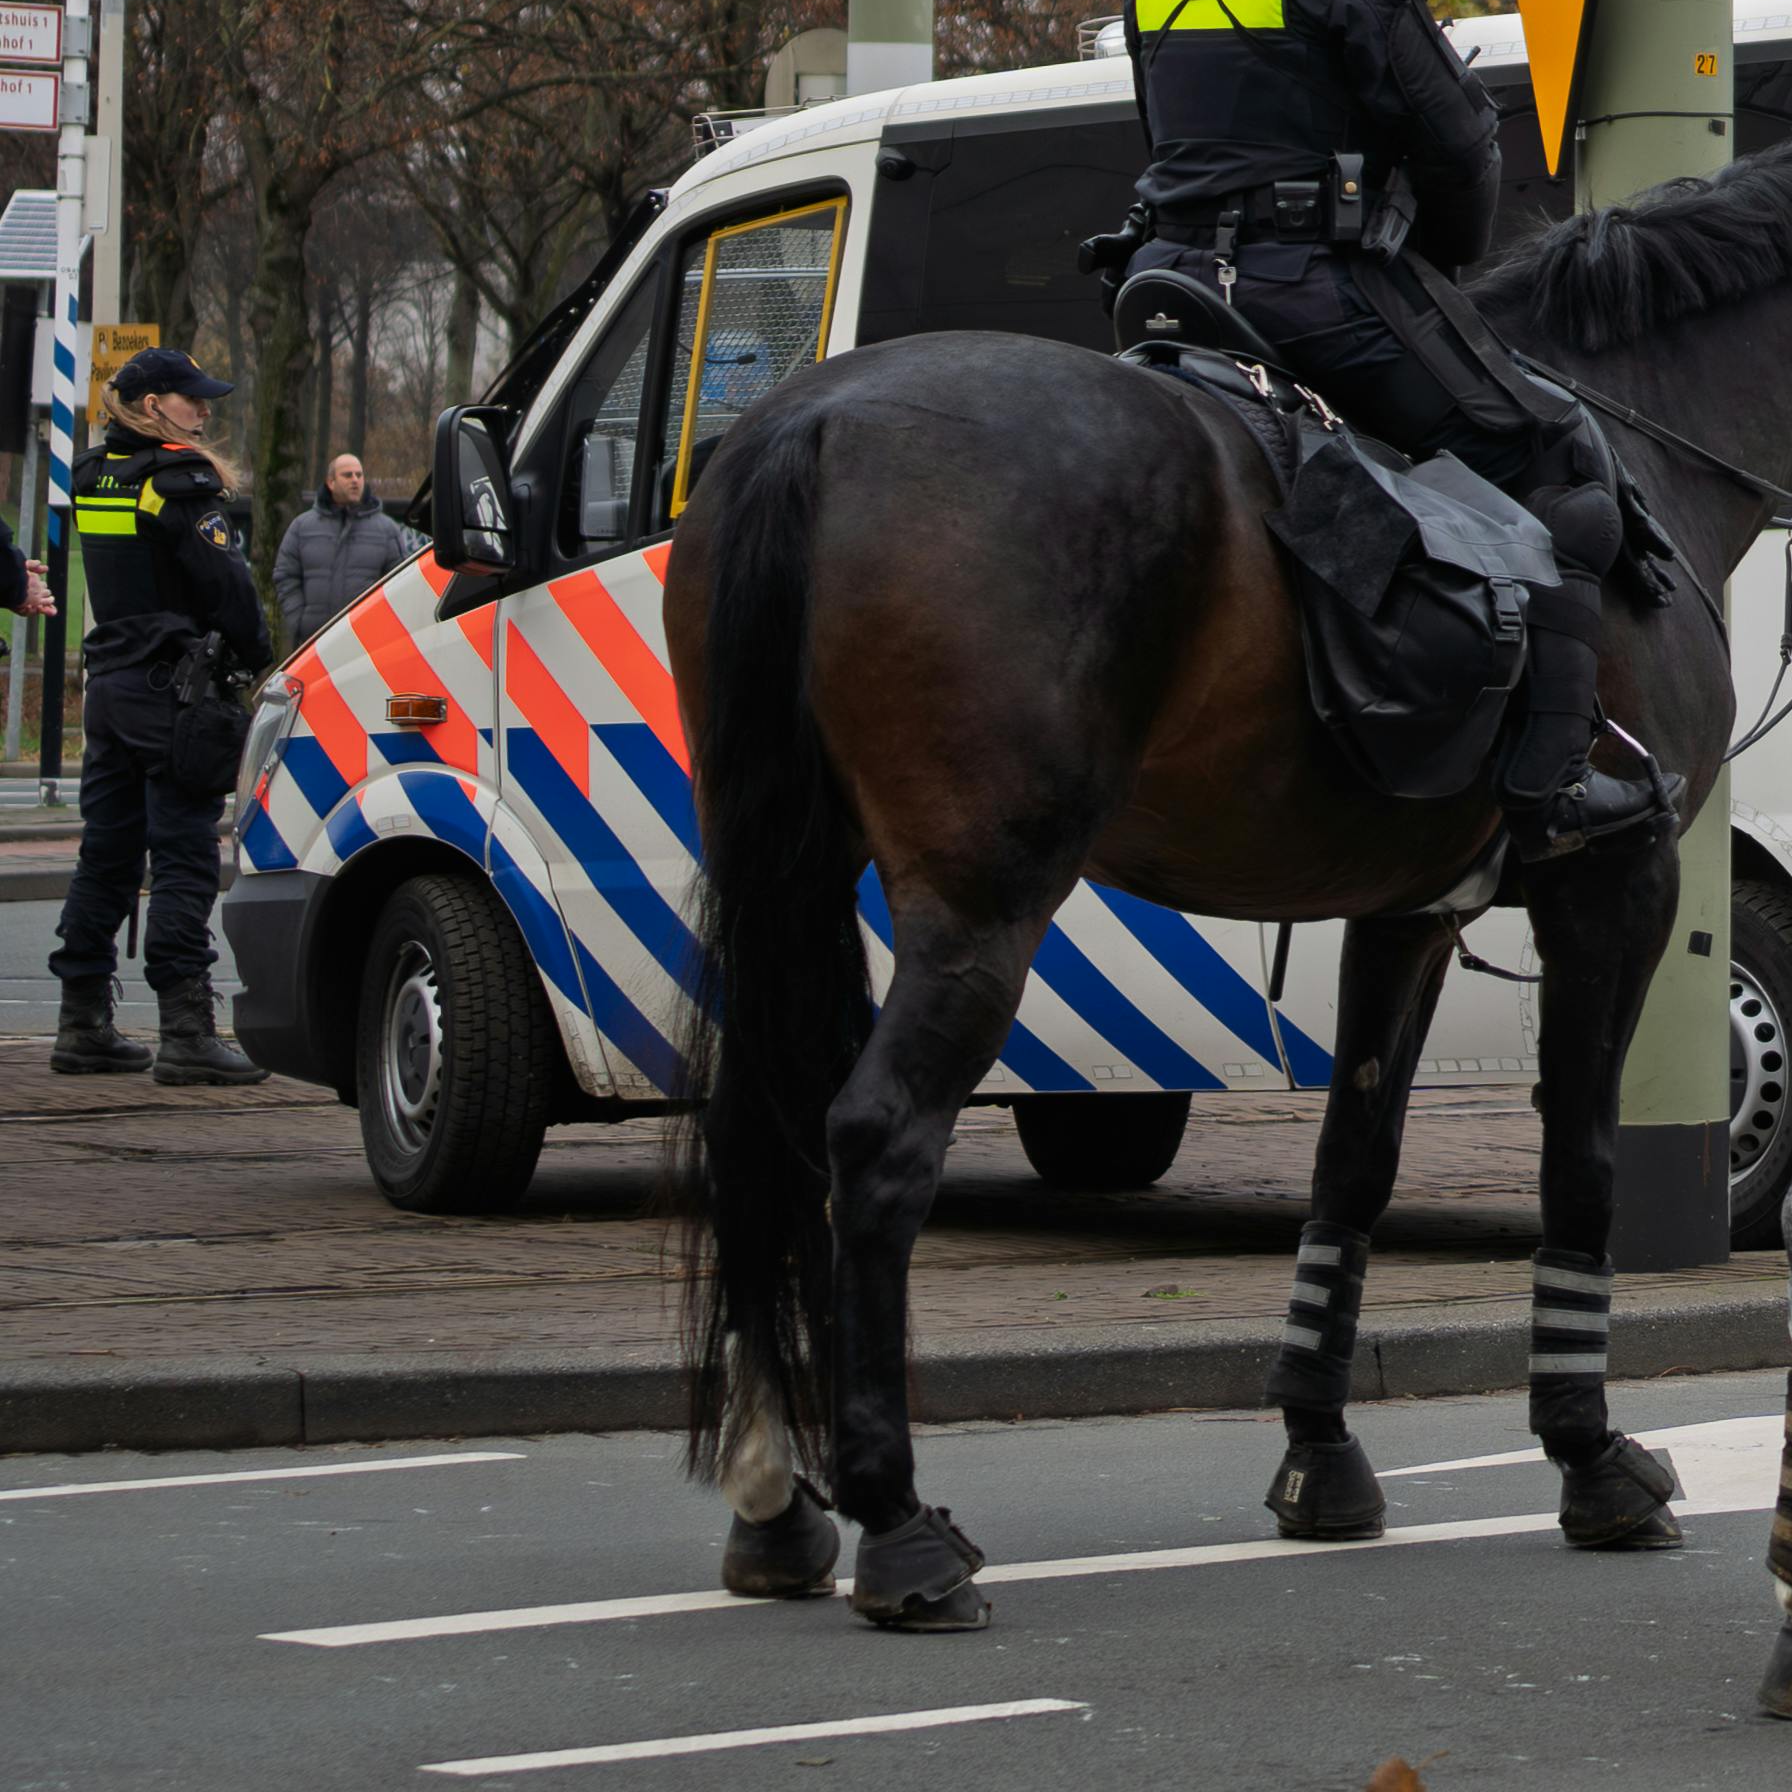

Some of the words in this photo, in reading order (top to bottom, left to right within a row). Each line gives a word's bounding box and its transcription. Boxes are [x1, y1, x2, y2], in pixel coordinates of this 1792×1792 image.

[43, 16, 48, 28] 1
[28, 39, 33, 50] 1
[1697, 54, 1715, 74] 27
[27, 82, 32, 94] 1
